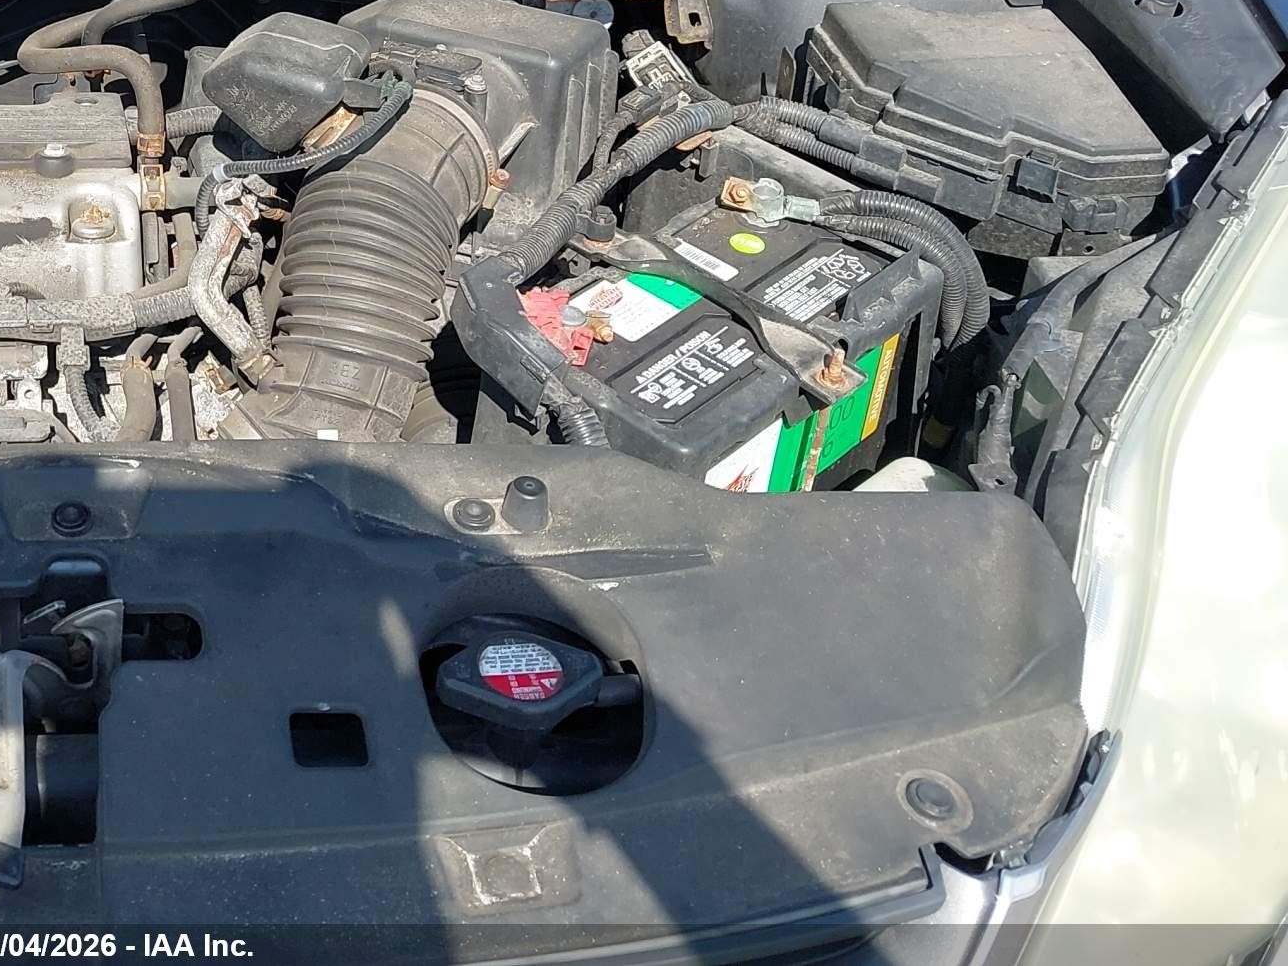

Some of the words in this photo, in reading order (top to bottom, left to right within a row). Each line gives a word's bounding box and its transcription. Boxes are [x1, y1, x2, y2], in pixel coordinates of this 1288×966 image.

[642, 354, 677, 383] DANGER
[680, 330, 712, 354] POISON
[869, 348, 894, 421] AUTOMOTIVE
